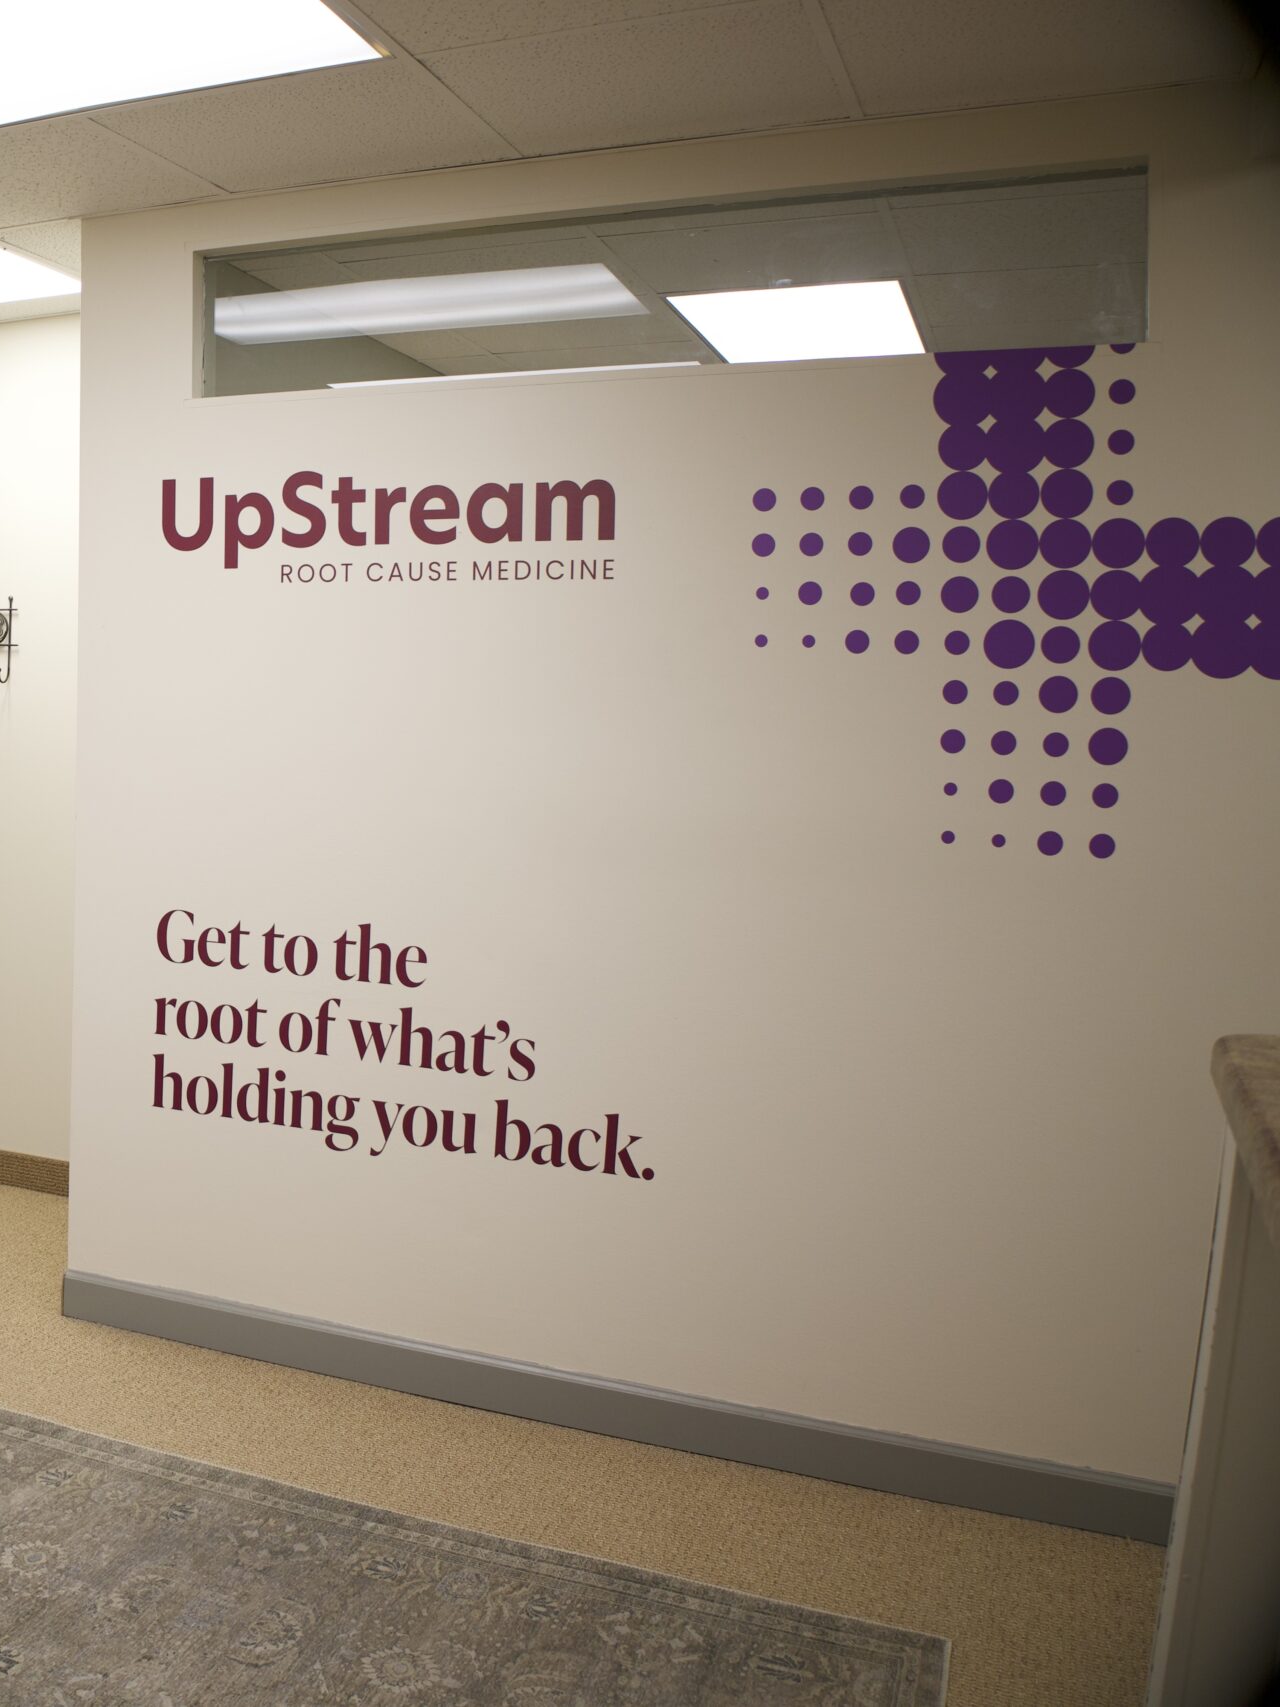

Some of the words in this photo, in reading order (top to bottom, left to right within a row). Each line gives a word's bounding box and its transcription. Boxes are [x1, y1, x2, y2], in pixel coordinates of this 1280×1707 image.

[161, 470, 616, 570] UpStream
[280, 563, 353, 584] ROOT
[366, 561, 458, 583] CAUSE
[472, 559, 615, 581] MEDICINE
[156, 909, 251, 971] Get
[261, 923, 319, 977] to
[333, 922, 428, 989] the
[154, 997, 268, 1048] root
[278, 997, 342, 1057] of
[347, 1006, 536, 1082] what’s
[151, 1053, 361, 1152] holding
[369, 1099, 477, 1157] you
[493, 1098, 655, 1181] back.
